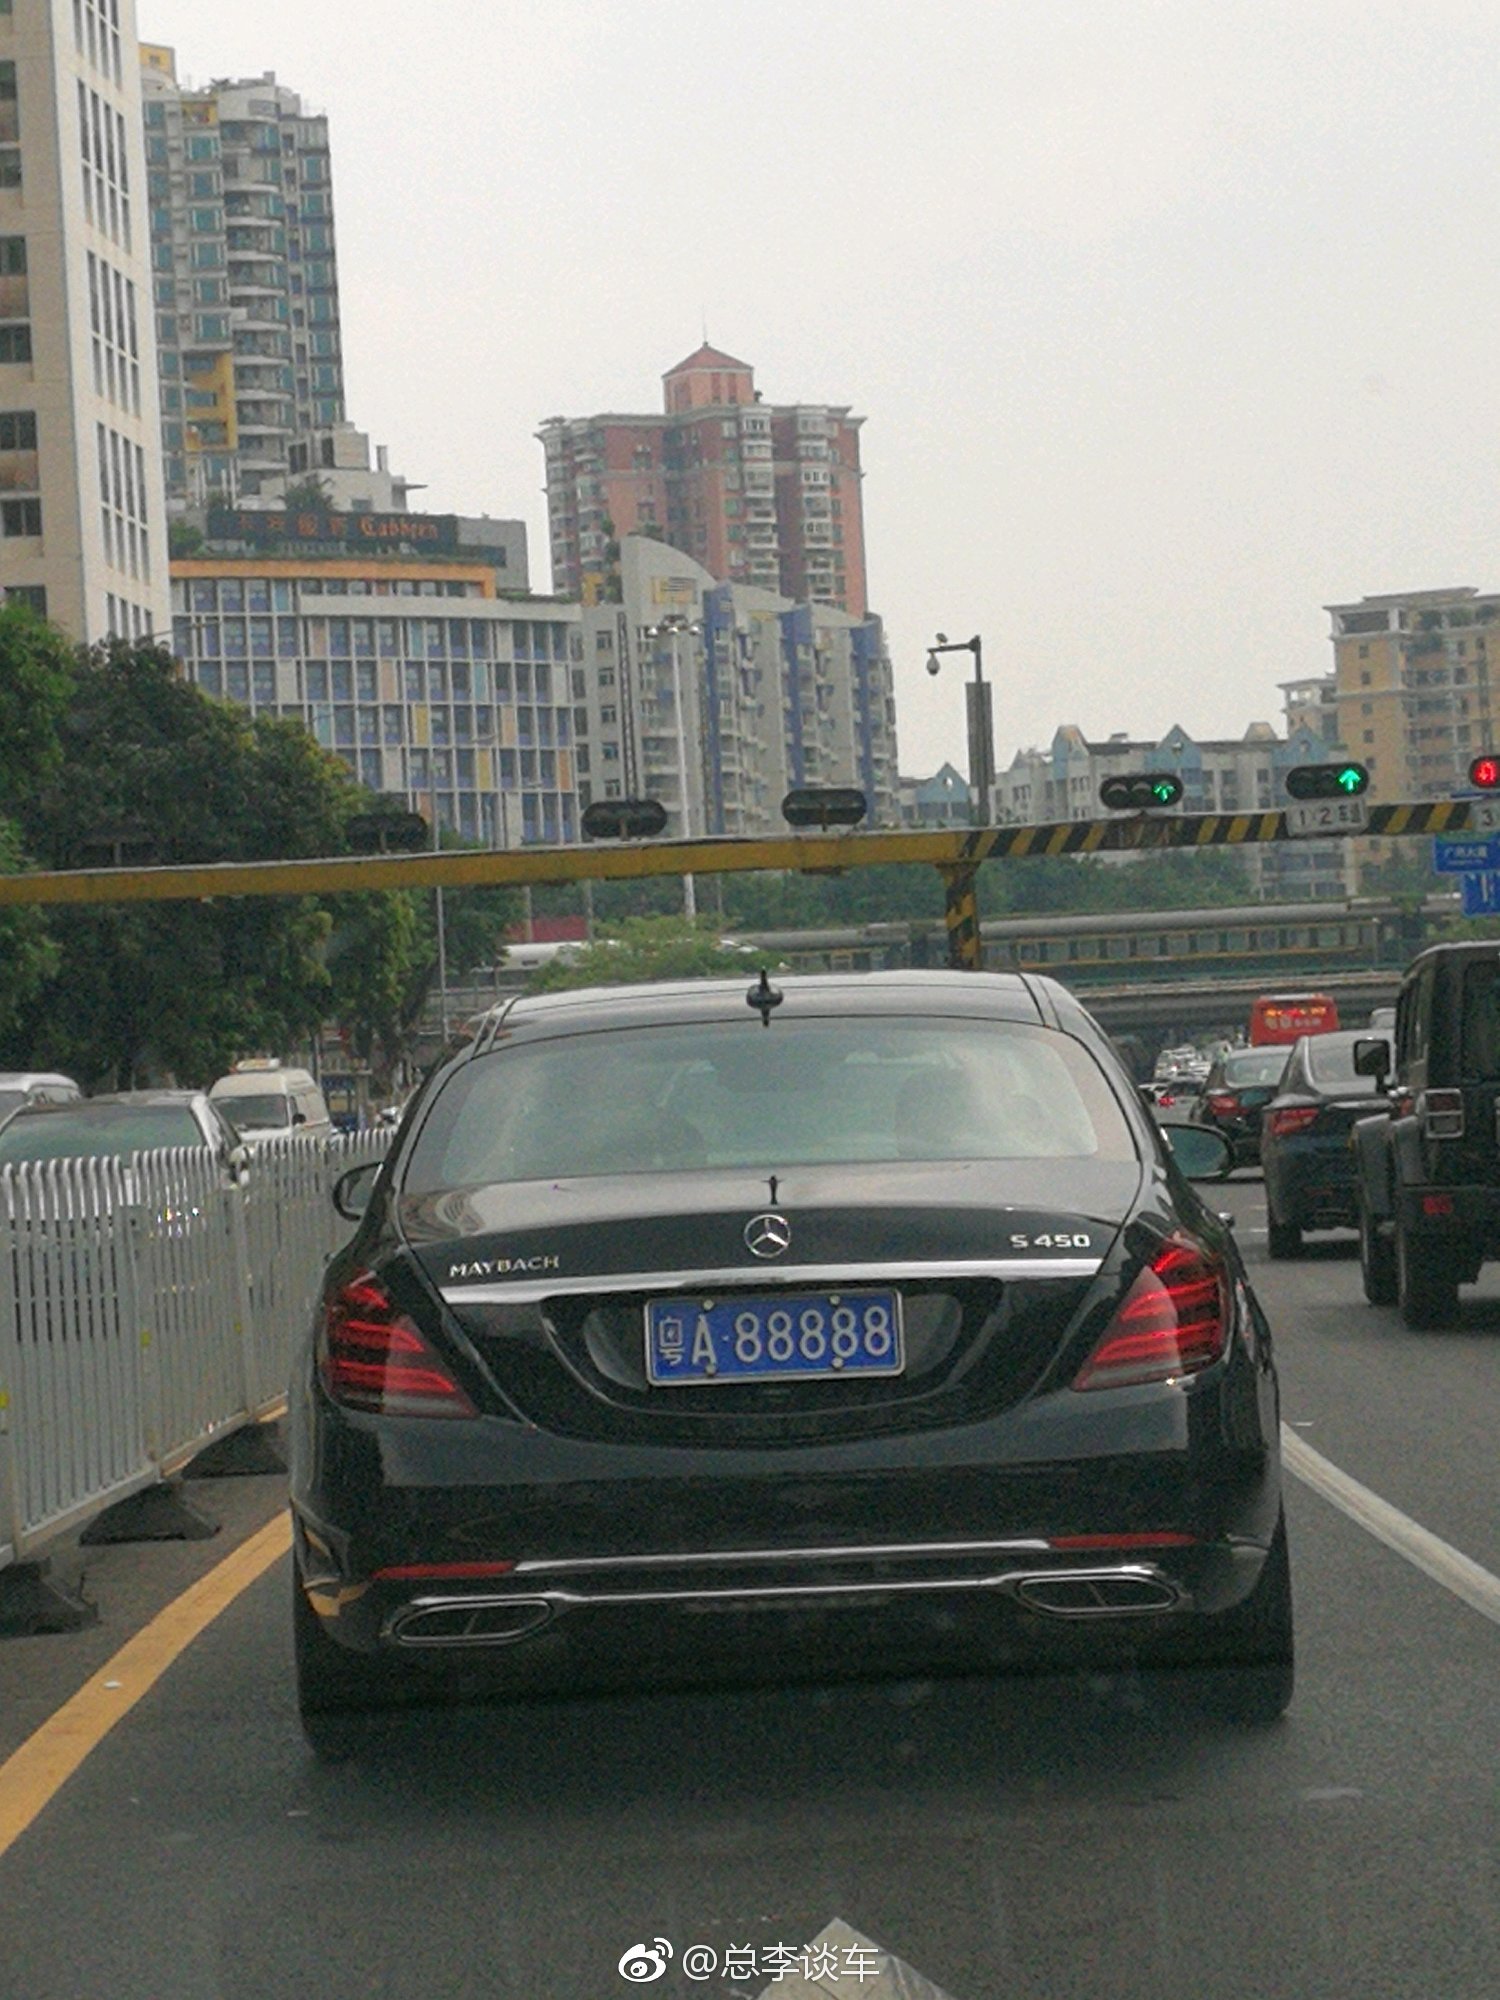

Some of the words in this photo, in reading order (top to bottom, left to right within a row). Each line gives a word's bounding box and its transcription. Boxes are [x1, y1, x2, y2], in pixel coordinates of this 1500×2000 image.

[1010, 1234, 1028, 1249] S
[1034, 1234, 1091, 1248] 450
[450, 1255, 559, 1277] MAYBACH
